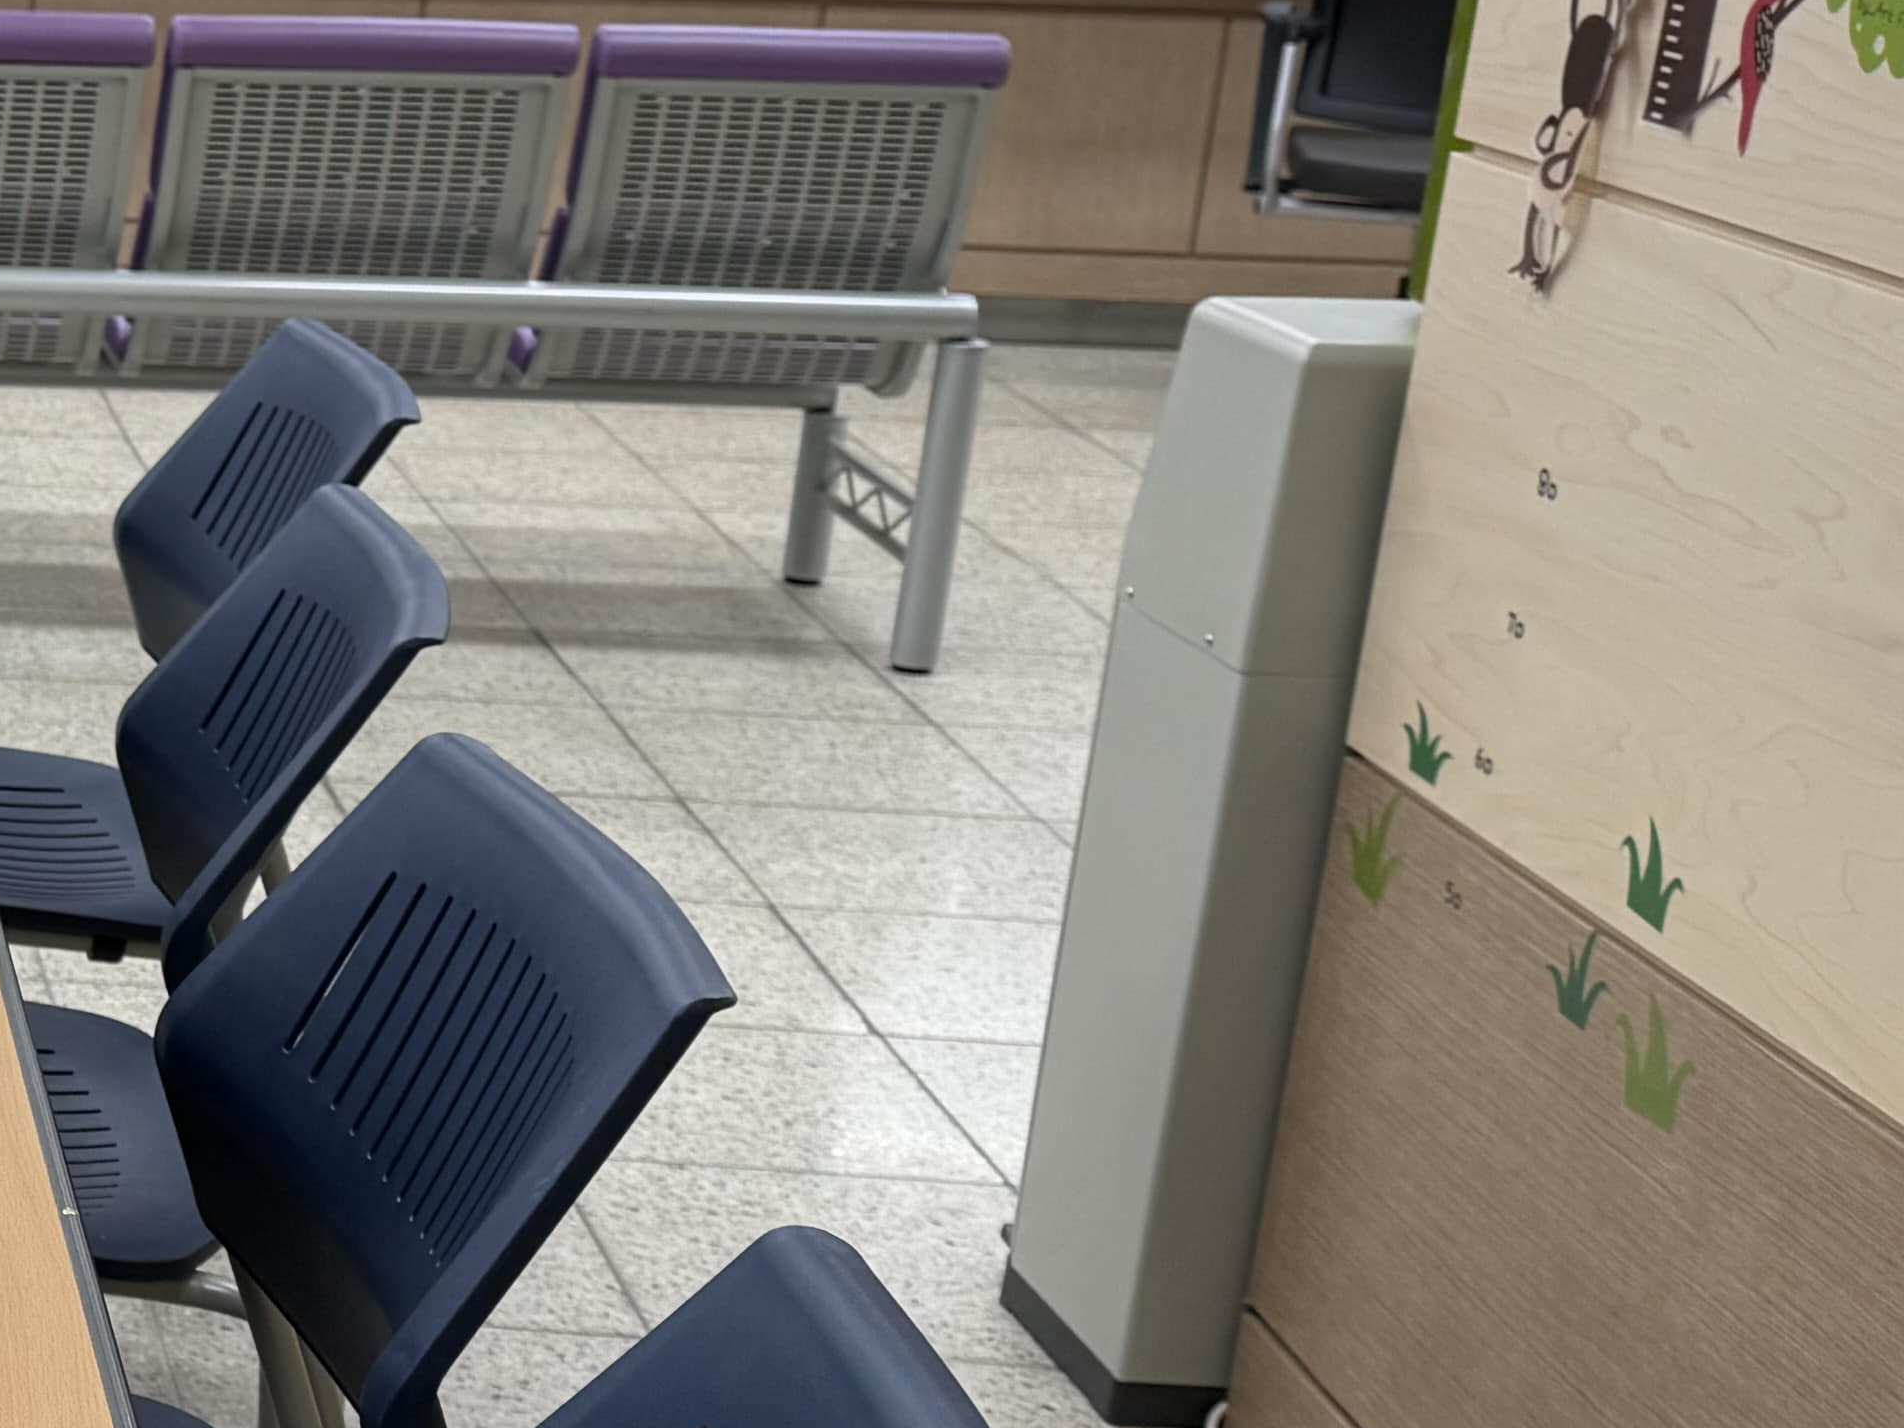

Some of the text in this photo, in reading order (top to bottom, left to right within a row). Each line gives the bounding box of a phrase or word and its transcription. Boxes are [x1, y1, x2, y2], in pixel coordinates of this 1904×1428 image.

[1537, 468, 1558, 501] 80
[1508, 610, 1525, 640] 70
[1475, 748, 1494, 776] 60
[1445, 880, 1462, 910] 50
